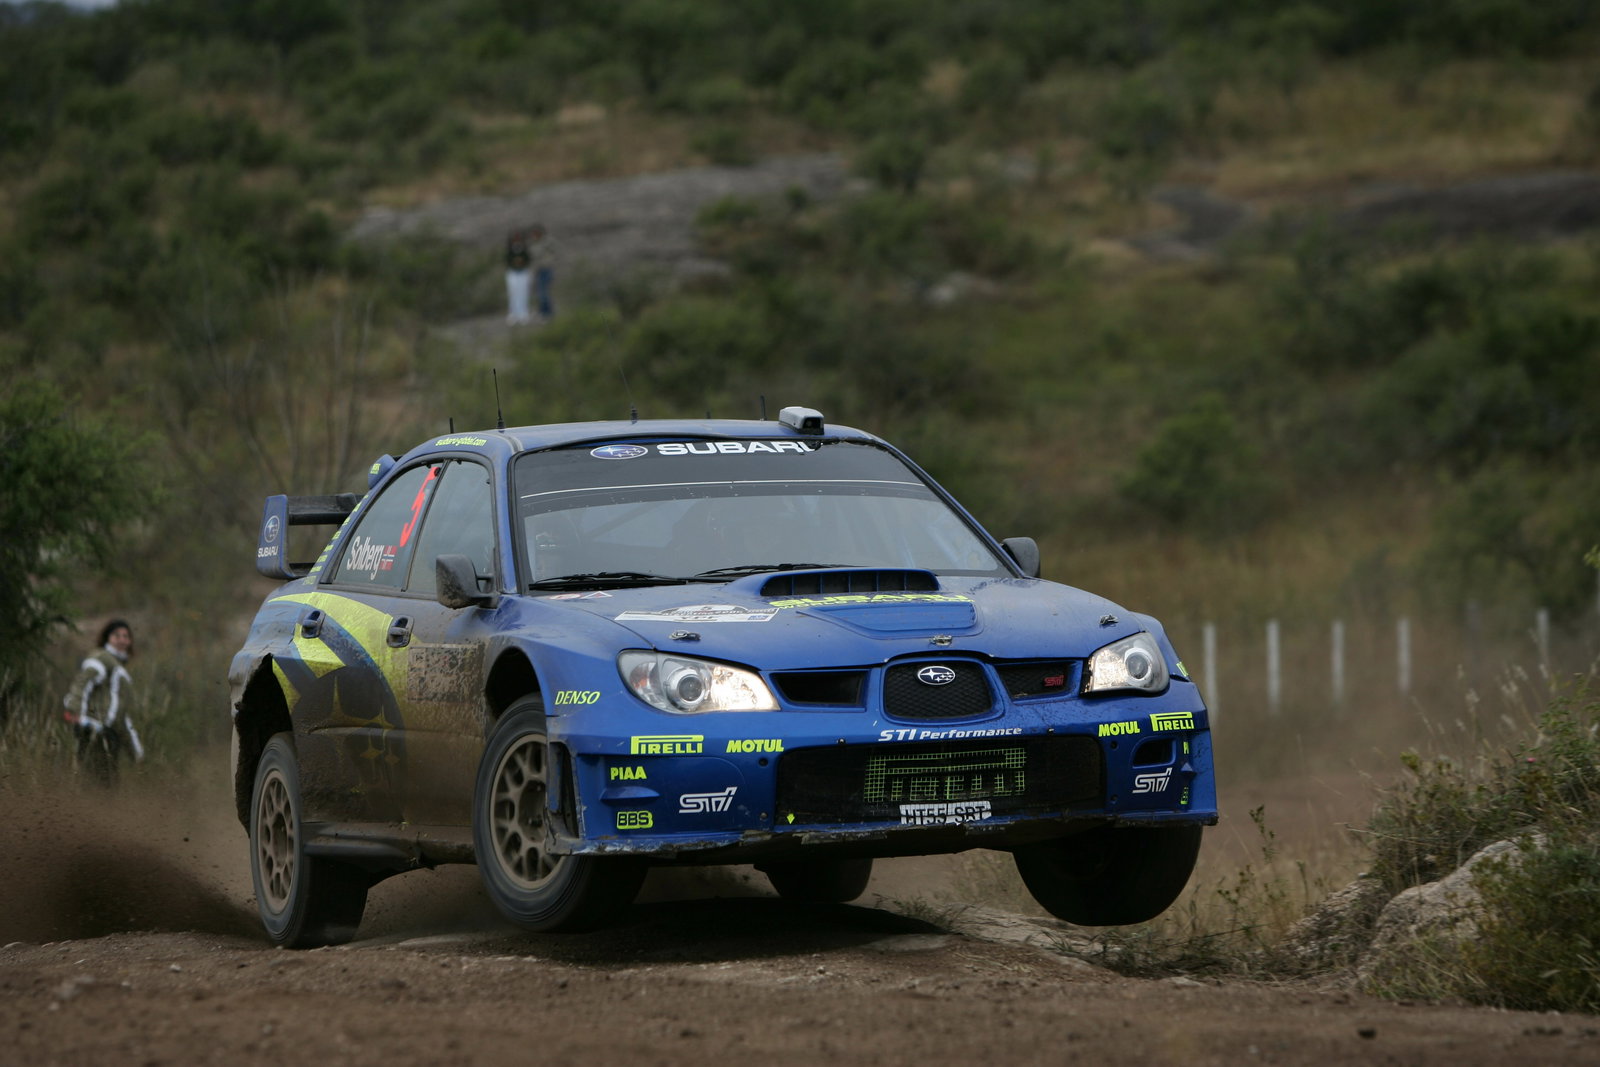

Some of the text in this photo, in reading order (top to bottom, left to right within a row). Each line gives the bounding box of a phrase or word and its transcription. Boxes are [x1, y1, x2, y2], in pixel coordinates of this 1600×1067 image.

[258, 545, 279, 558] SUBARU
[346, 536, 386, 580] Solberg
[769, 594, 969, 607] SUBARU
[554, 690, 601, 706] DENSO
[1098, 720, 1141, 737] MOTUL
[1149, 711, 1195, 732] PIRELLI
[878, 727, 1022, 742] STI Performance
[630, 734, 704, 755] PIRELLI
[726, 739, 785, 753] MOTUL
[610, 766, 647, 781] PIAA
[616, 811, 653, 830] BBS
